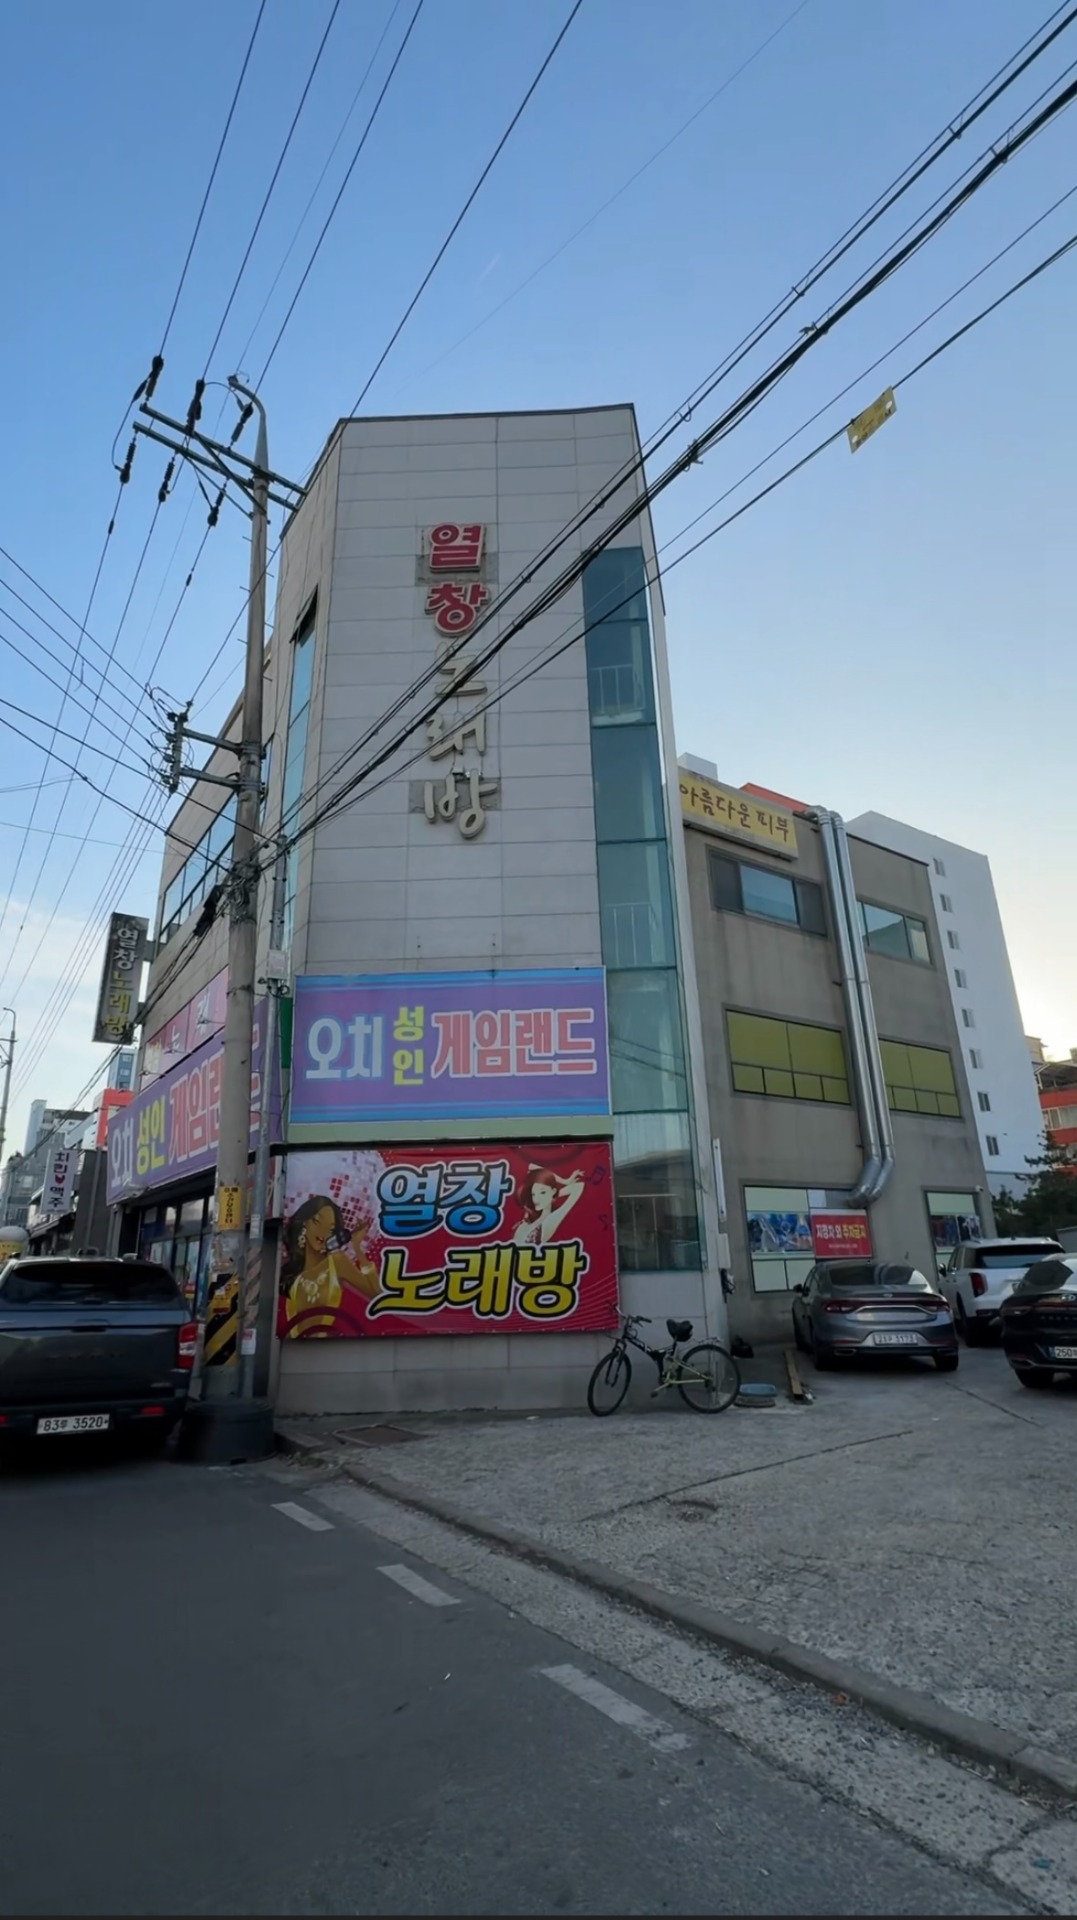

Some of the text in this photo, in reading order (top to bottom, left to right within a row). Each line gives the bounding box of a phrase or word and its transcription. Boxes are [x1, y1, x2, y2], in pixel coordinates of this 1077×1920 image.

[425, 522, 492, 637] 열창
[679, 783, 790, 842] 아름다운 피부
[113, 927, 139, 970] 열창
[305, 1006, 597, 1085] 오치 성인 게임랜드
[111, 1116, 134, 1187] 오치
[137, 1096, 166, 1175] 성인
[376, 1160, 513, 1237] 열창
[365, 1240, 589, 1320] 노래방
[73, 1415, 104, 1429] 3520
